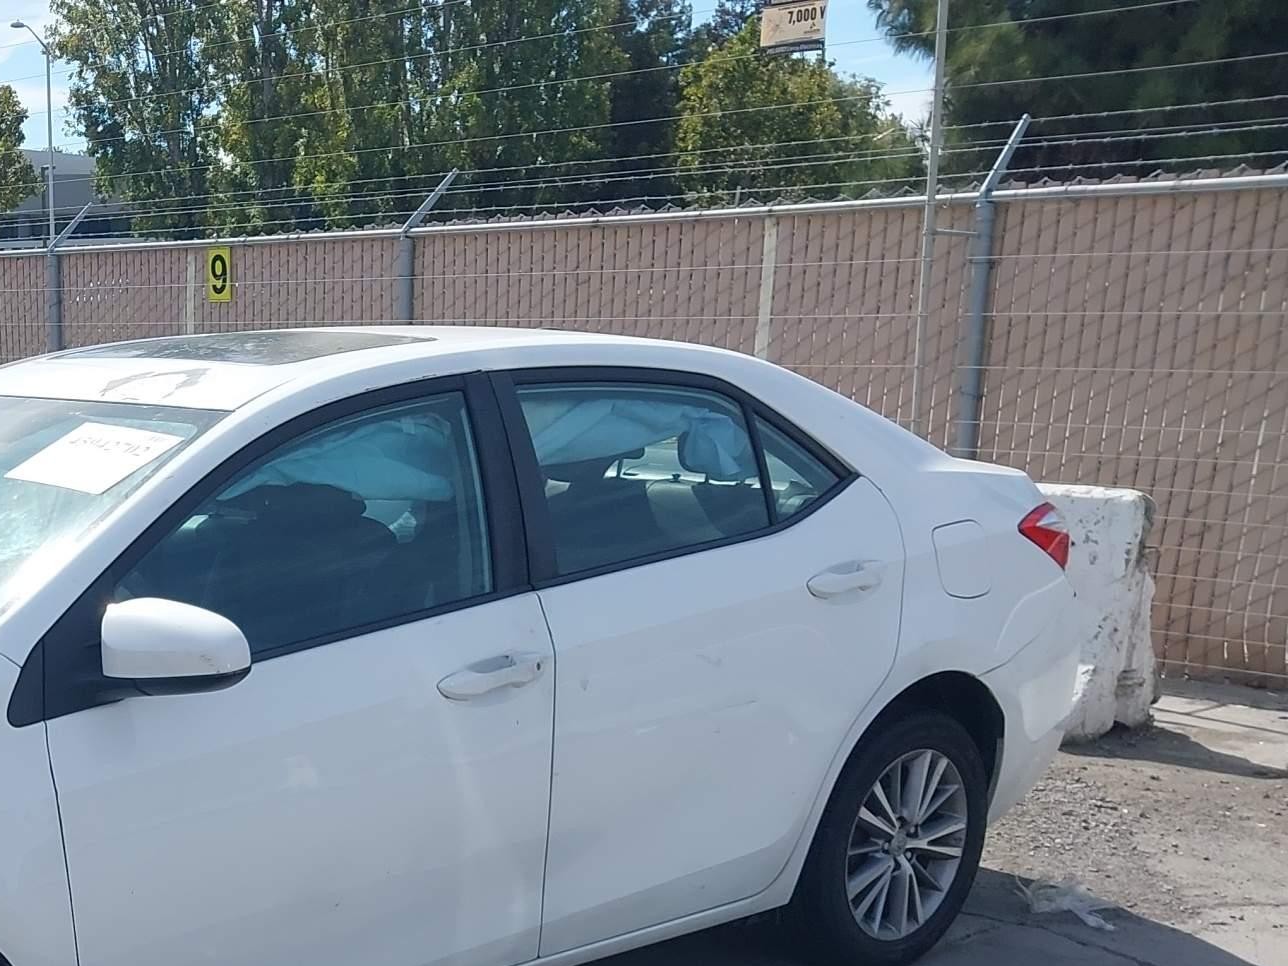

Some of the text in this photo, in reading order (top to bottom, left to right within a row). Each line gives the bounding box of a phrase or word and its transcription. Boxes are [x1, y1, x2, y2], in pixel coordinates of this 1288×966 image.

[787, 5, 827, 26] 7,000 V
[210, 254, 227, 294] 9
